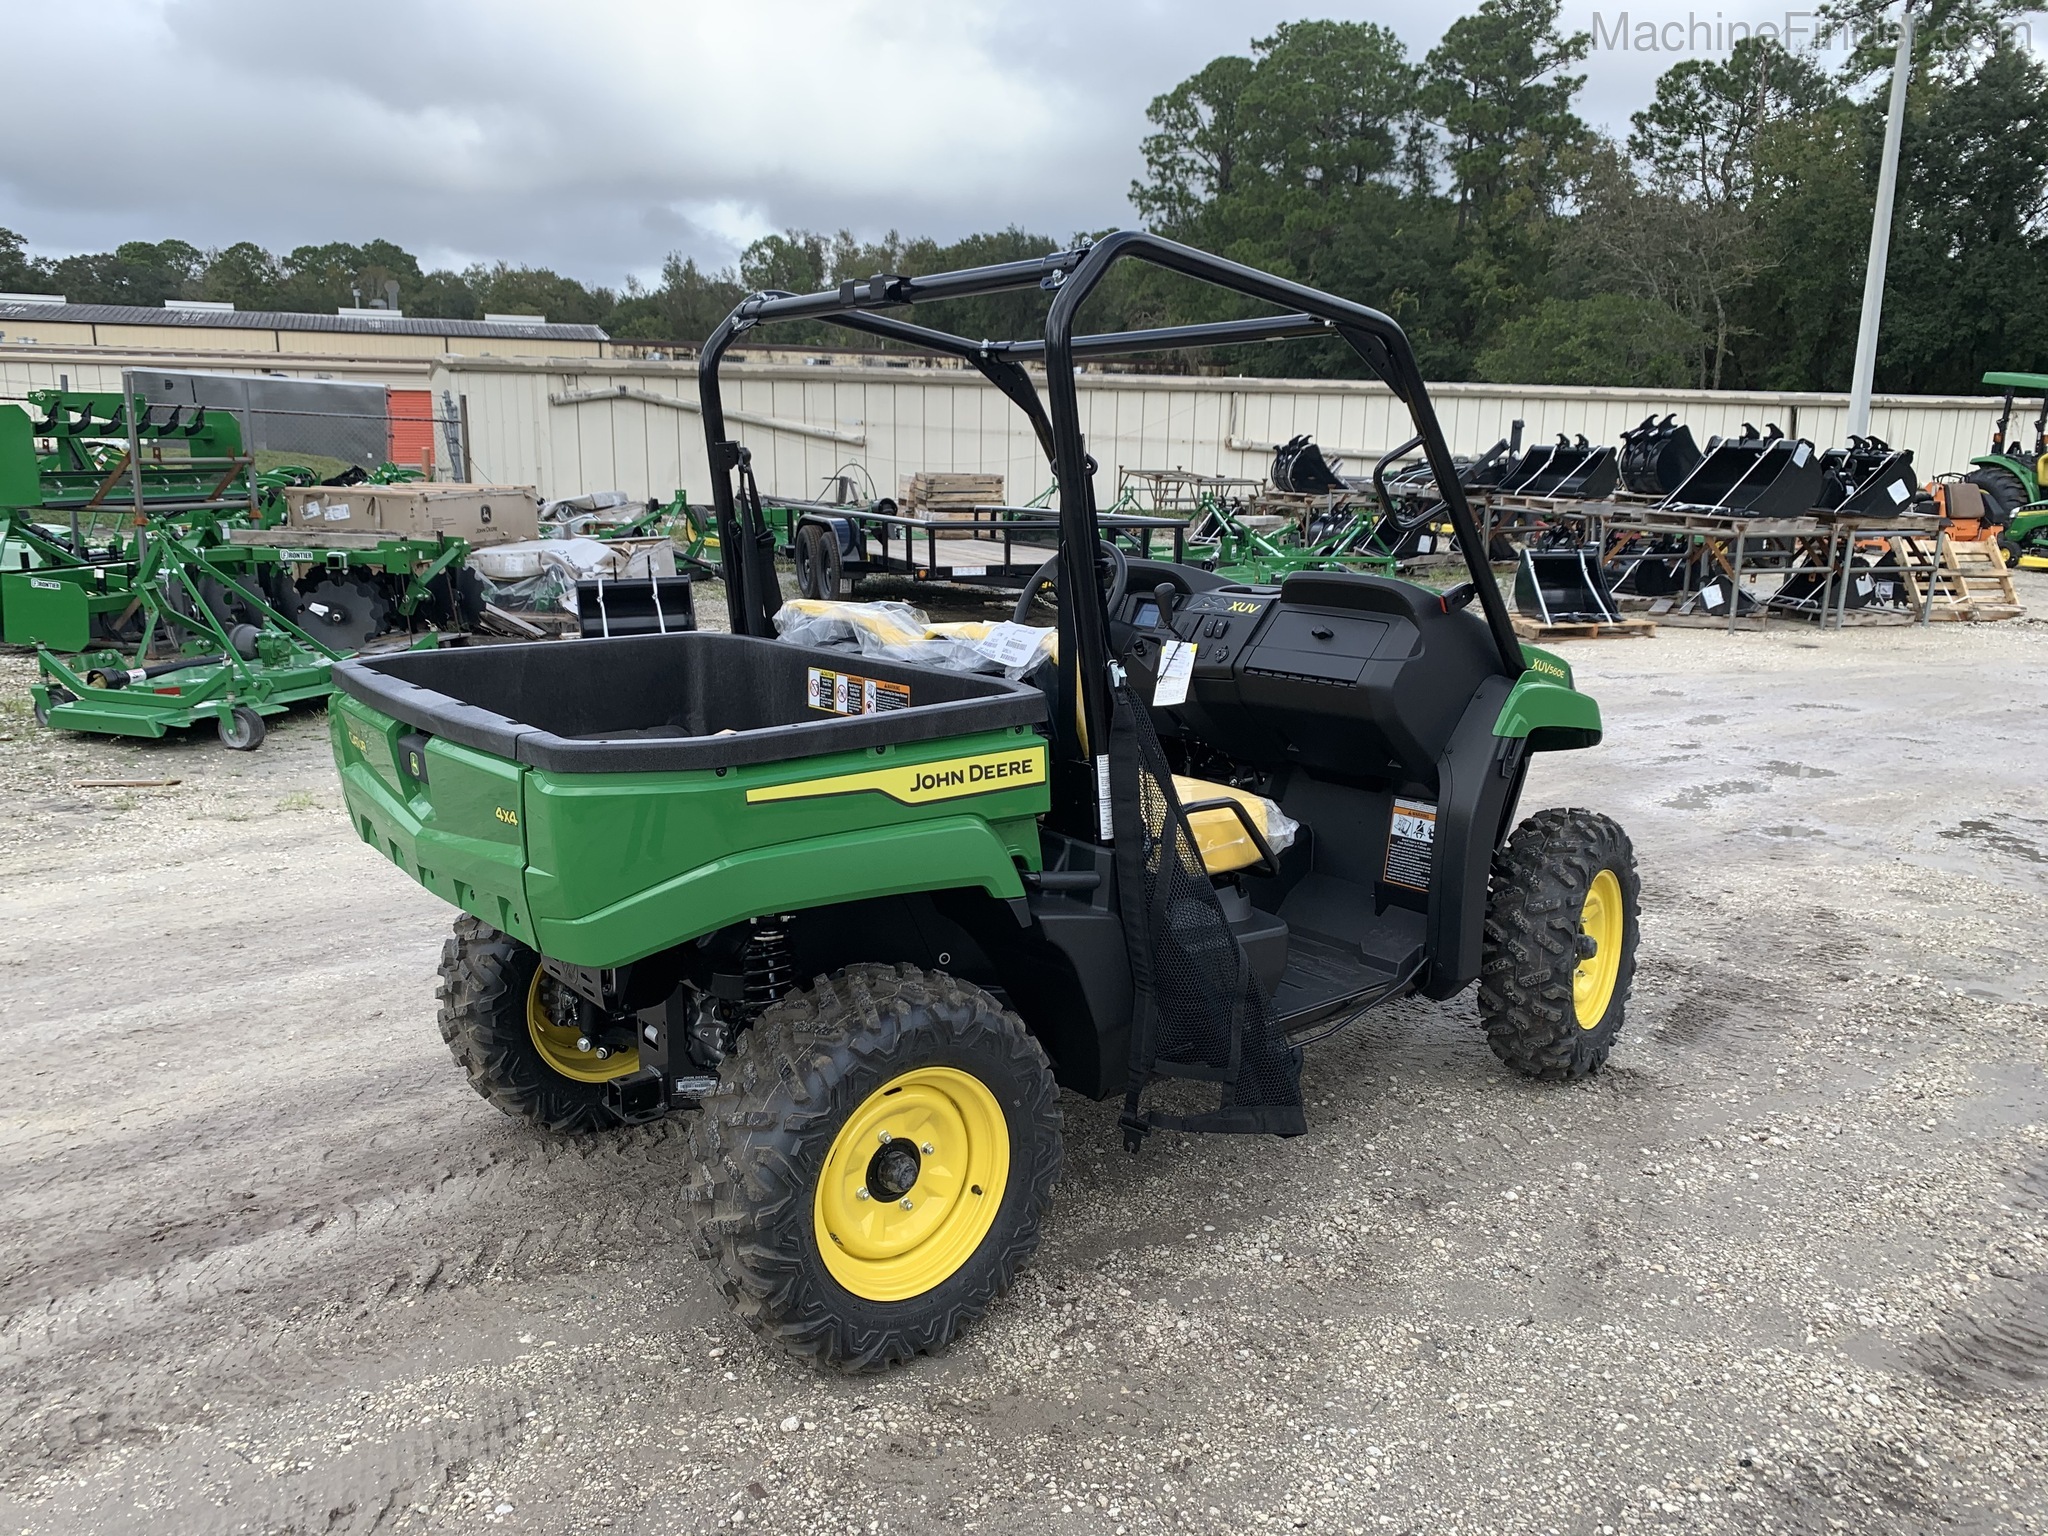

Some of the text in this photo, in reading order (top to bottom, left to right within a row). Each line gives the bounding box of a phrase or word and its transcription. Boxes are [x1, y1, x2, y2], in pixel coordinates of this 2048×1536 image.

[1227, 601, 1262, 613] XUV
[1532, 658, 1566, 679] XUV560E
[910, 759, 1033, 792] JOHN DEERE
